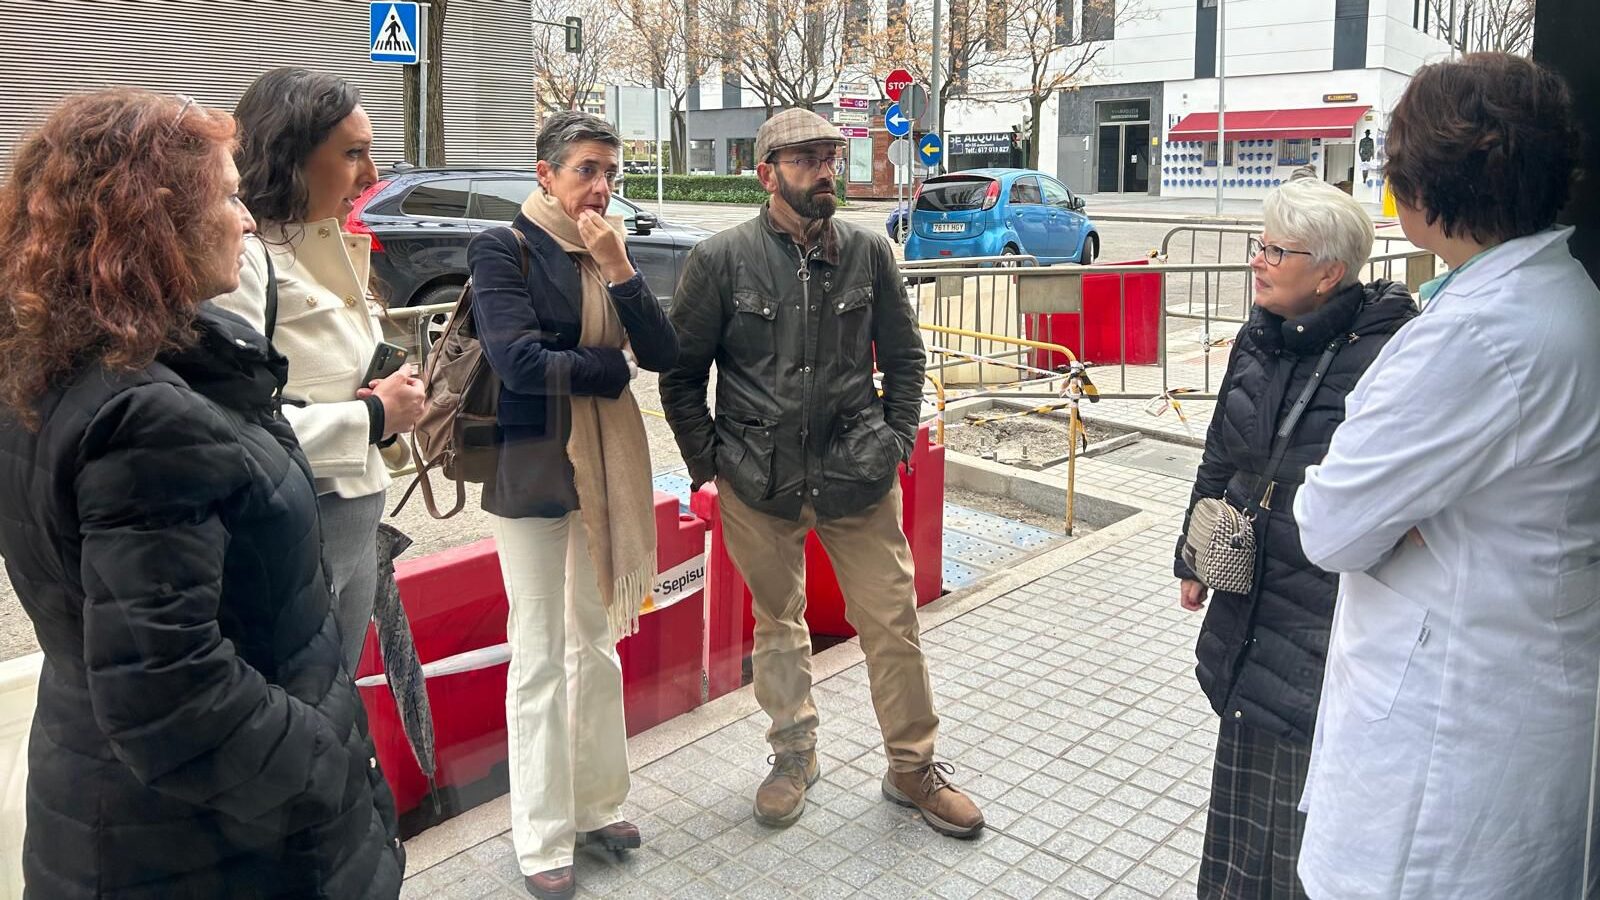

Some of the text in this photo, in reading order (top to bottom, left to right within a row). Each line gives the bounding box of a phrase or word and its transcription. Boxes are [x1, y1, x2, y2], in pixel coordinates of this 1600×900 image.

[964, 134, 1009, 143] ALQUILA
[1082, 135, 1090, 150] 1
[662, 566, 704, 595] Sepisu
